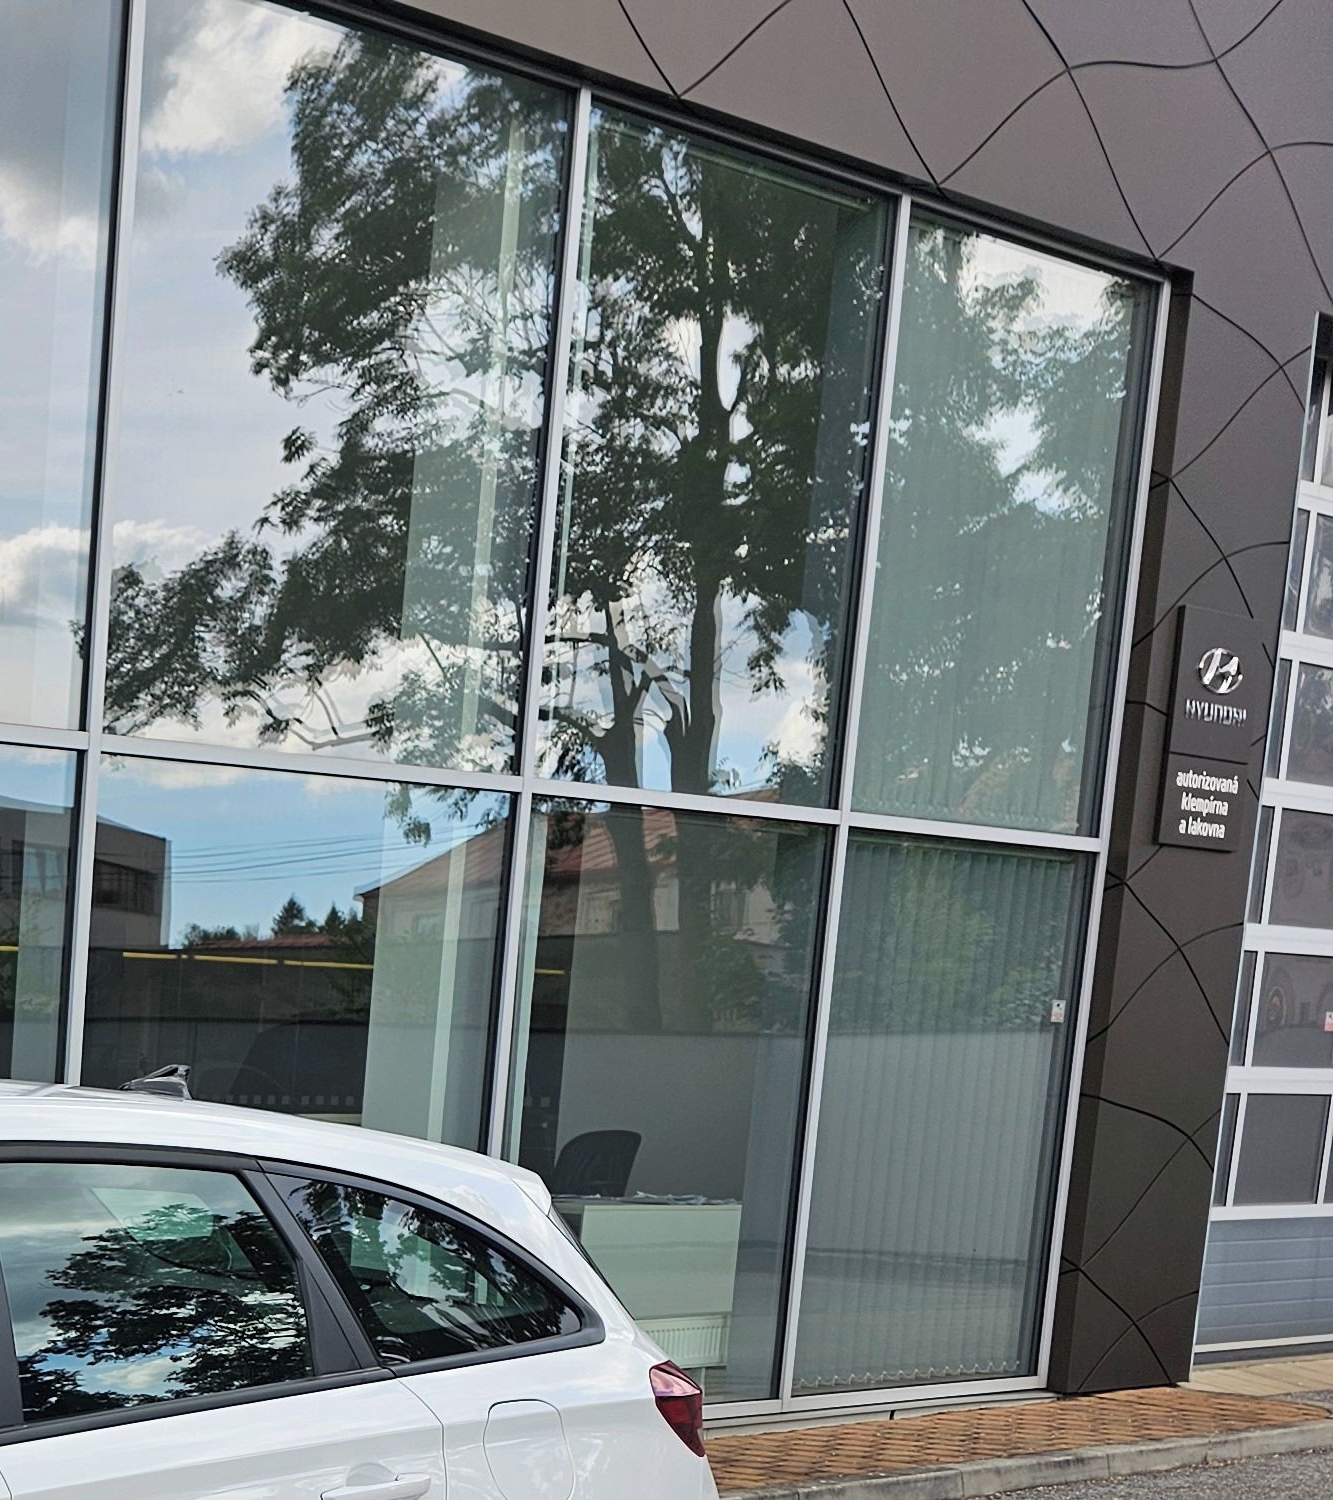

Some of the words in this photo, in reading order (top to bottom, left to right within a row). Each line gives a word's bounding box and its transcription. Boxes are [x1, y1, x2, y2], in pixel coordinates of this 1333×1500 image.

[1185, 698, 1247, 727] HYUNDAI
[1176, 769, 1238, 794] autorizovaná
[1180, 791, 1228, 817] klempírna
[1178, 818, 1187, 834] a
[1187, 815, 1225, 839] lakovna
